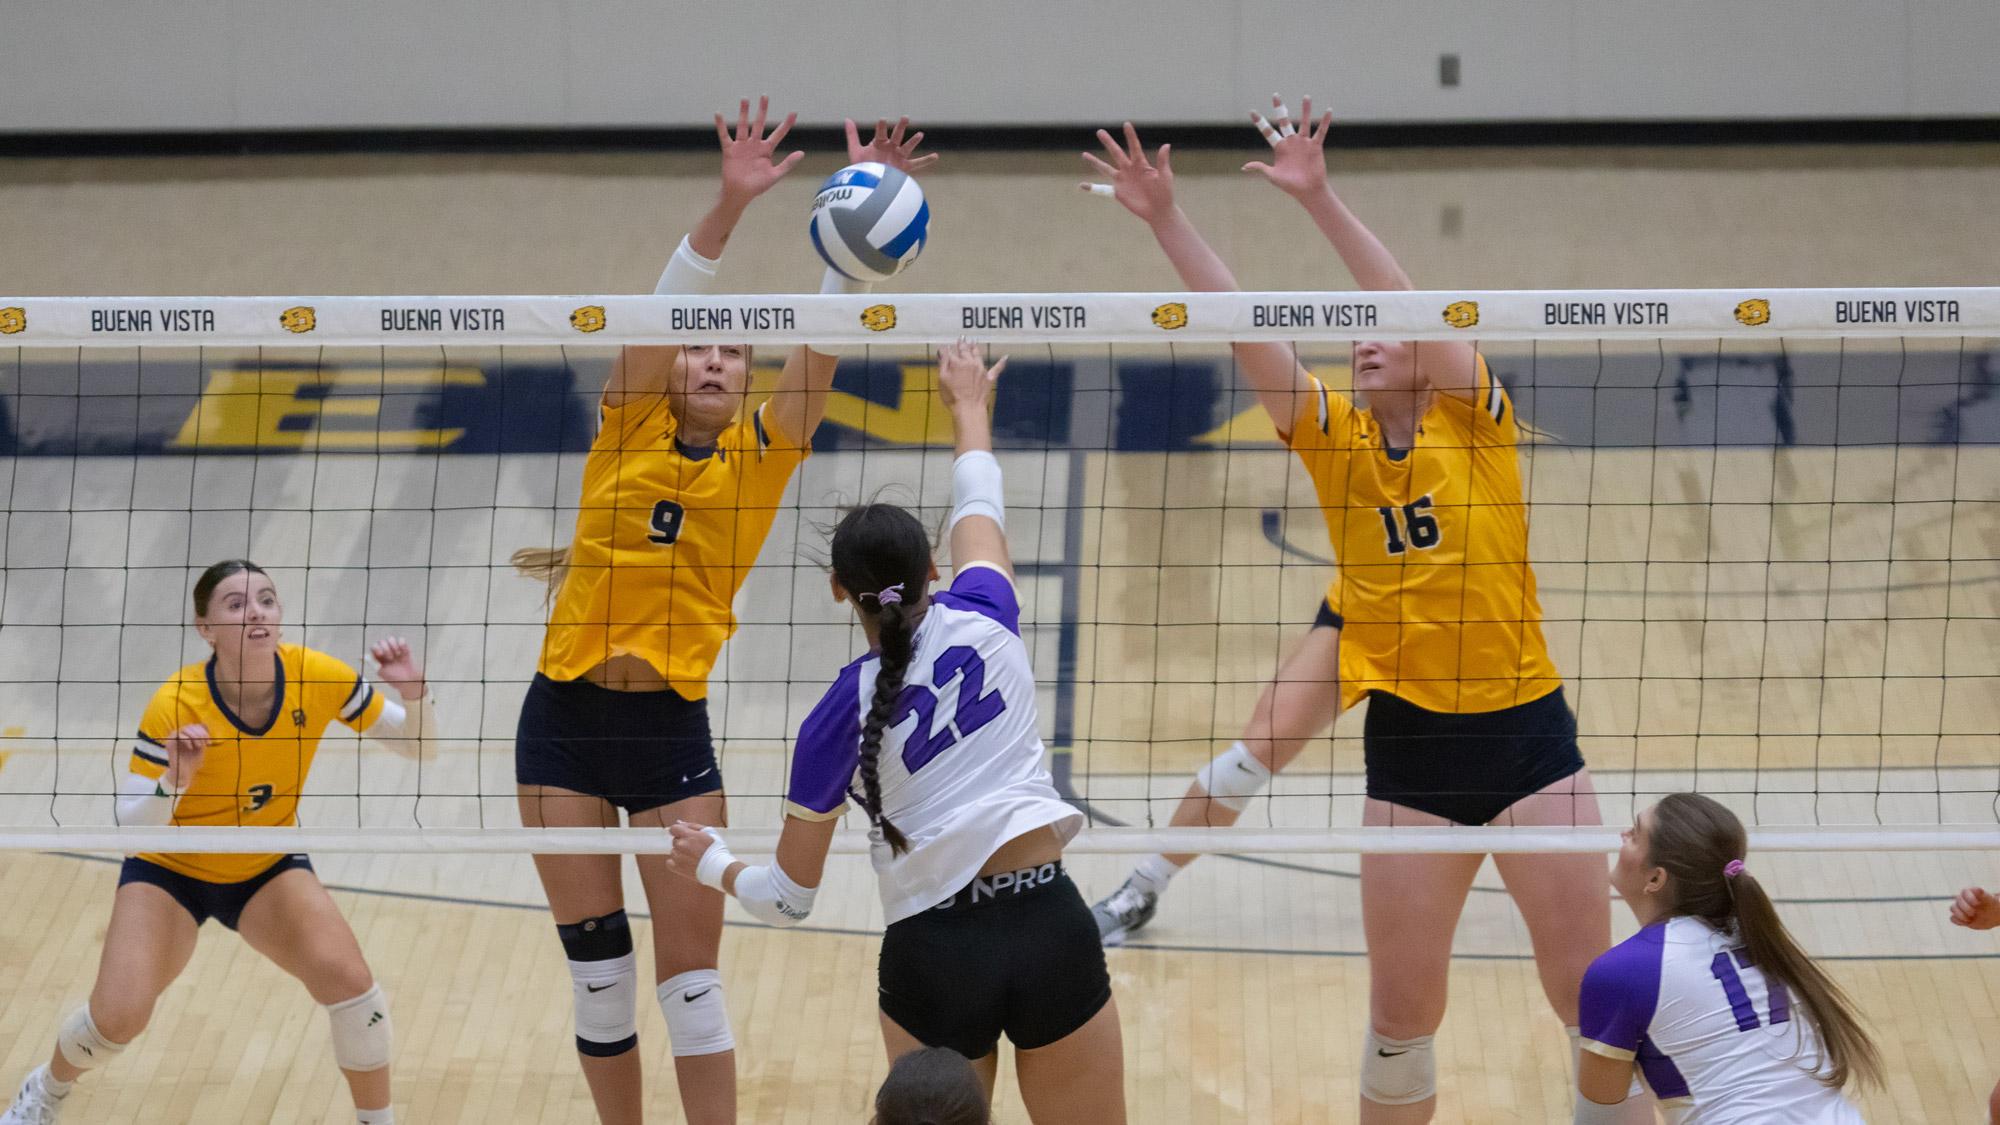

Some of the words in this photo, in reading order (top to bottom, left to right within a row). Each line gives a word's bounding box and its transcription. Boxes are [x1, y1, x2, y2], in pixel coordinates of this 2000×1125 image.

[91, 309, 152, 332] BUENA
[159, 309, 215, 332] VISTA
[381, 308, 442, 331] BUENA
[449, 308, 505, 331] VISTA
[671, 308, 732, 331] BUENA
[739, 307, 795, 330] VISTA
[962, 306, 1023, 329] BUENA
[1030, 306, 1086, 329] VISTA
[1253, 304, 1315, 328] BUENA
[1322, 304, 1377, 327] VISTA
[1544, 302, 1606, 326] BUENA
[1613, 302, 1669, 325] VISTA
[1835, 300, 1897, 324] BUENA
[1904, 300, 1960, 323] VISTA
[646, 498, 686, 547] 9
[1376, 493, 1442, 556] 16
[886, 646, 1007, 775] 22
[241, 783, 276, 814] 3
[1710, 946, 1791, 1033] 17
